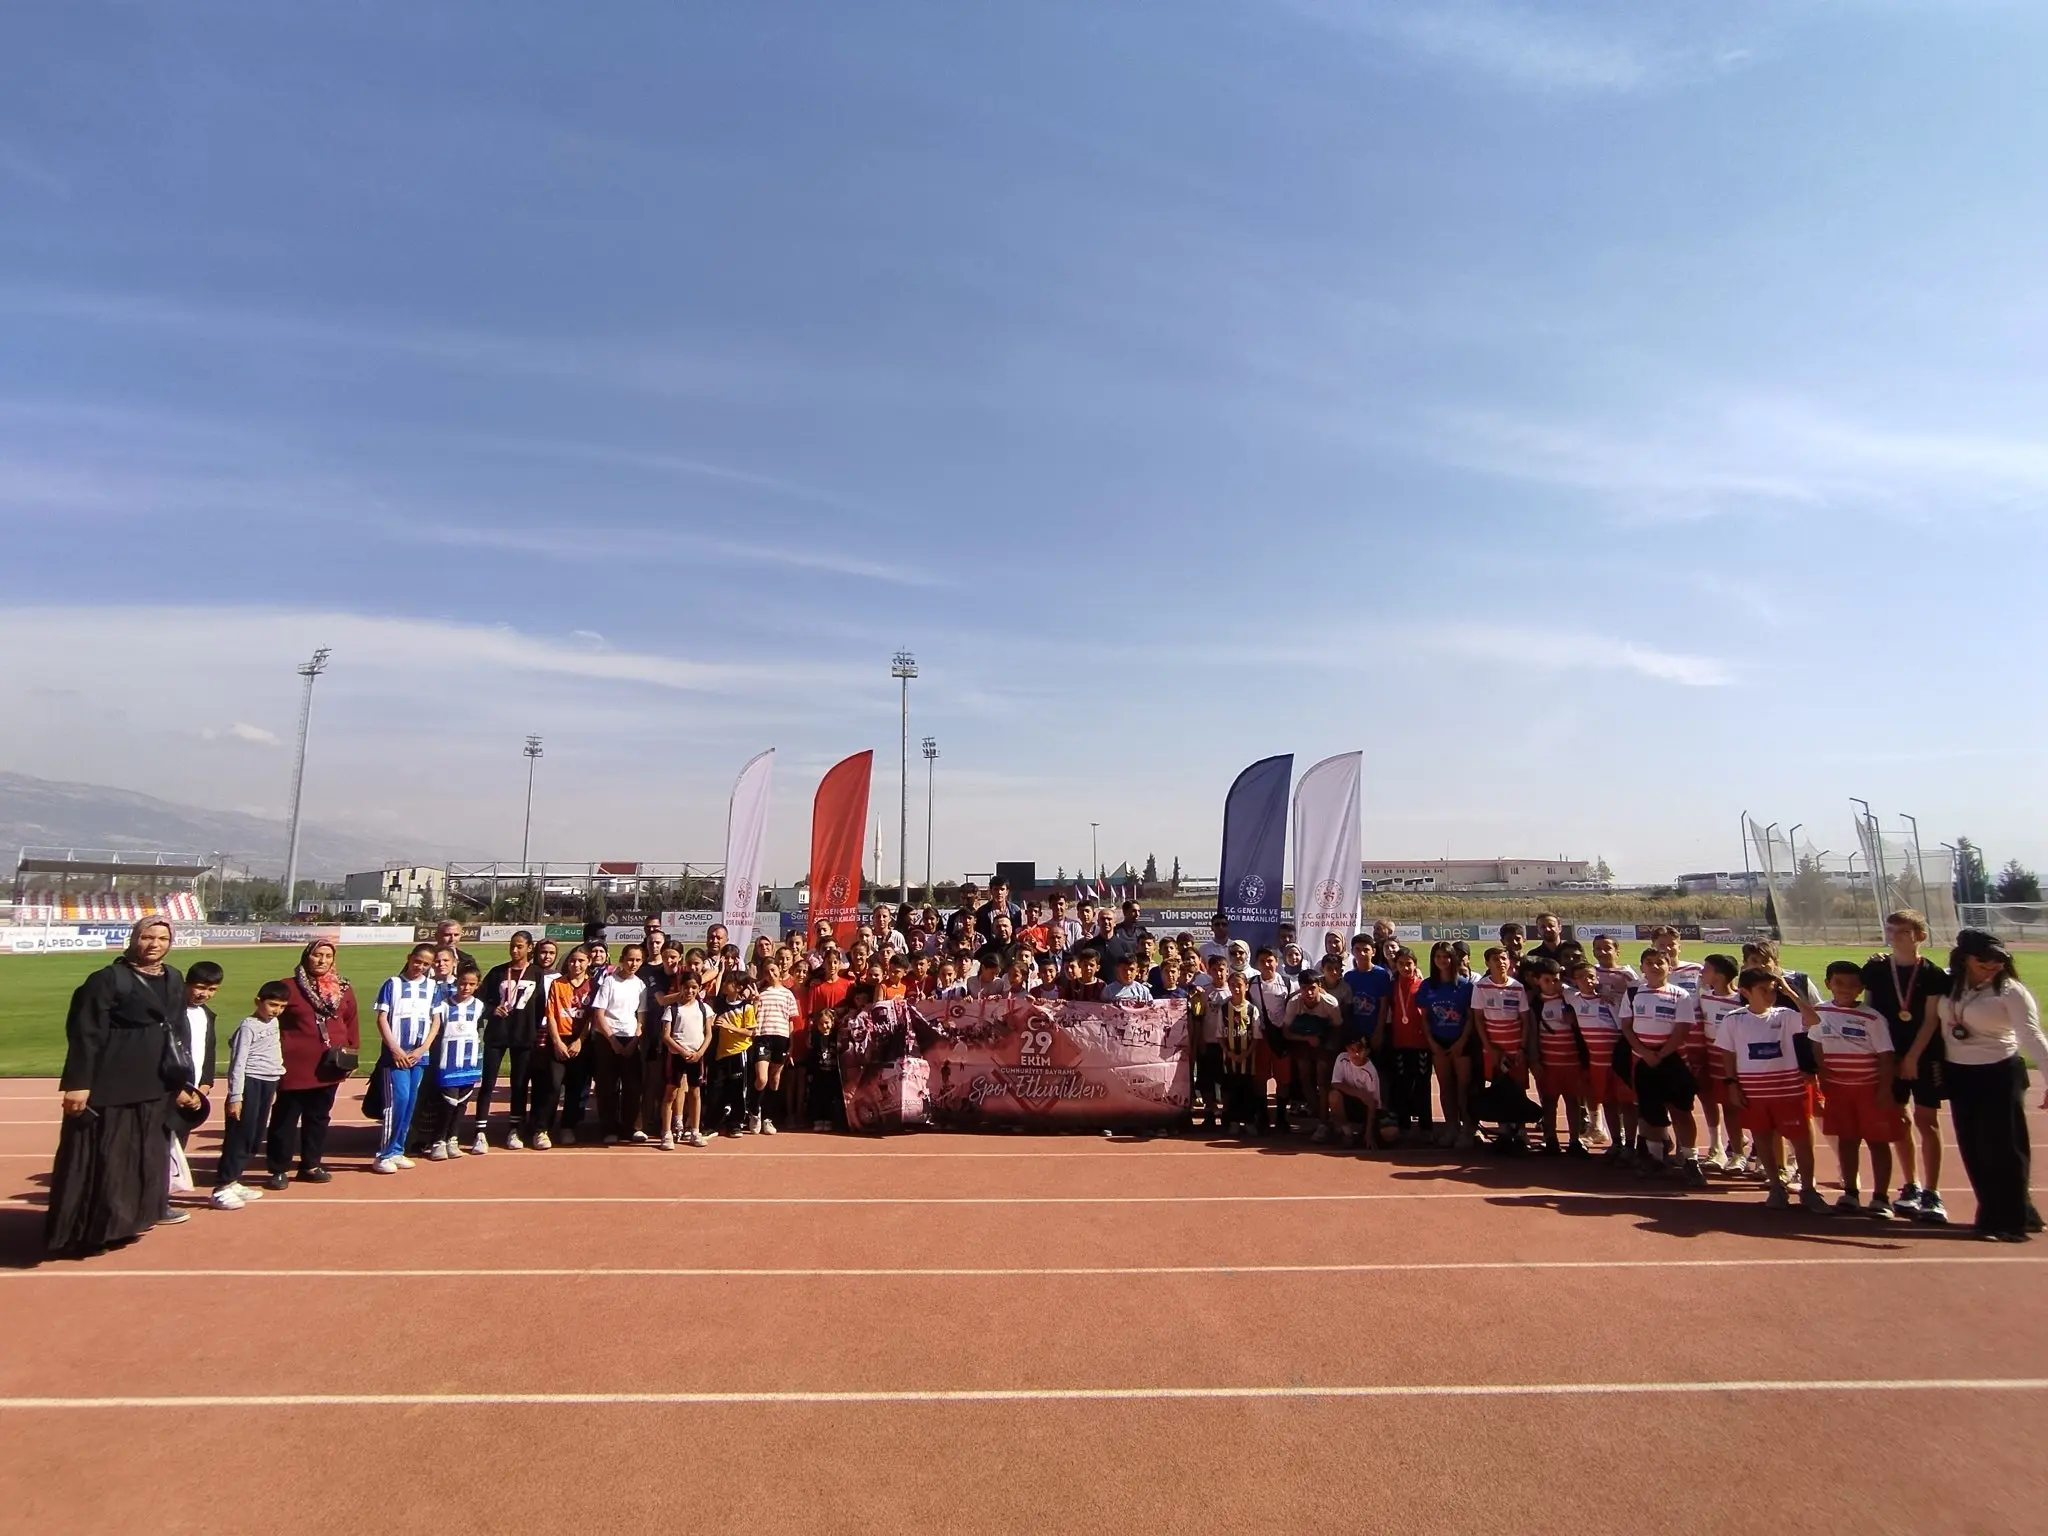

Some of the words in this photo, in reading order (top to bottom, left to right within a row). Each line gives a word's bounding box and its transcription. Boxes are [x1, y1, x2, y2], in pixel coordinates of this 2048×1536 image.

[678, 913, 713, 921] ASMED
[1160, 909, 1179, 920] TÜM
[213, 930, 256, 939] MOTORS
[38, 938, 84, 948] ALPEDO
[1020, 1030, 1053, 1055] 29
[1020, 1055, 1051, 1066] EKİM
[1000, 1067, 1043, 1075] CUMHURİYET
[1044, 1068, 1076, 1076] BAYRAMI
[968, 1075, 1012, 1106] Spor
[1015, 1075, 1106, 1099] Etkinlikleri
